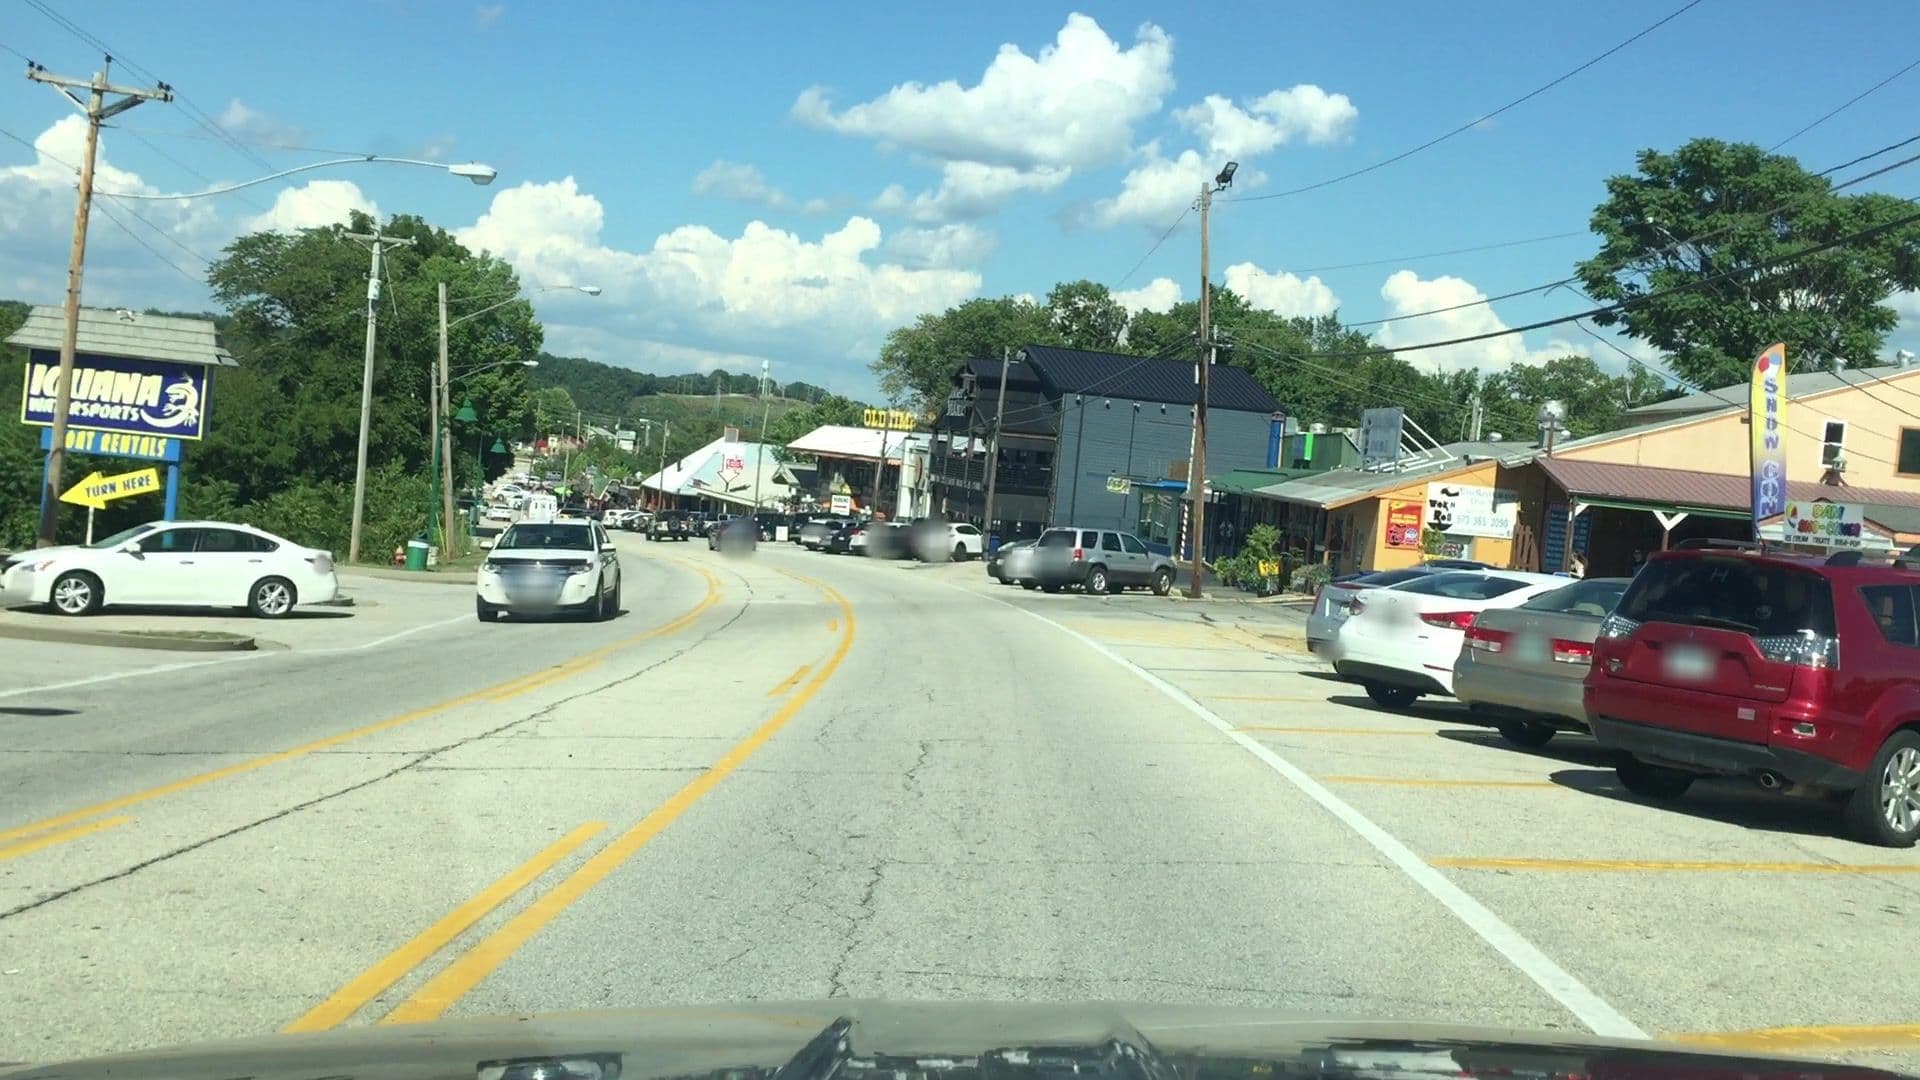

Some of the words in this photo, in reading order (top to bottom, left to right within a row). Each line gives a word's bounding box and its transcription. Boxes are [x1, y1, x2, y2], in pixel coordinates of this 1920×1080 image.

[29, 363, 163, 407] IGUANA
[28, 397, 140, 422] WATRSPORTS
[864, 408, 886, 428] OLD
[64, 430, 97, 451] OAT
[100, 432, 167, 458] RENTALS
[86, 482, 117, 498] TURN
[122, 475, 151, 492] HERE
